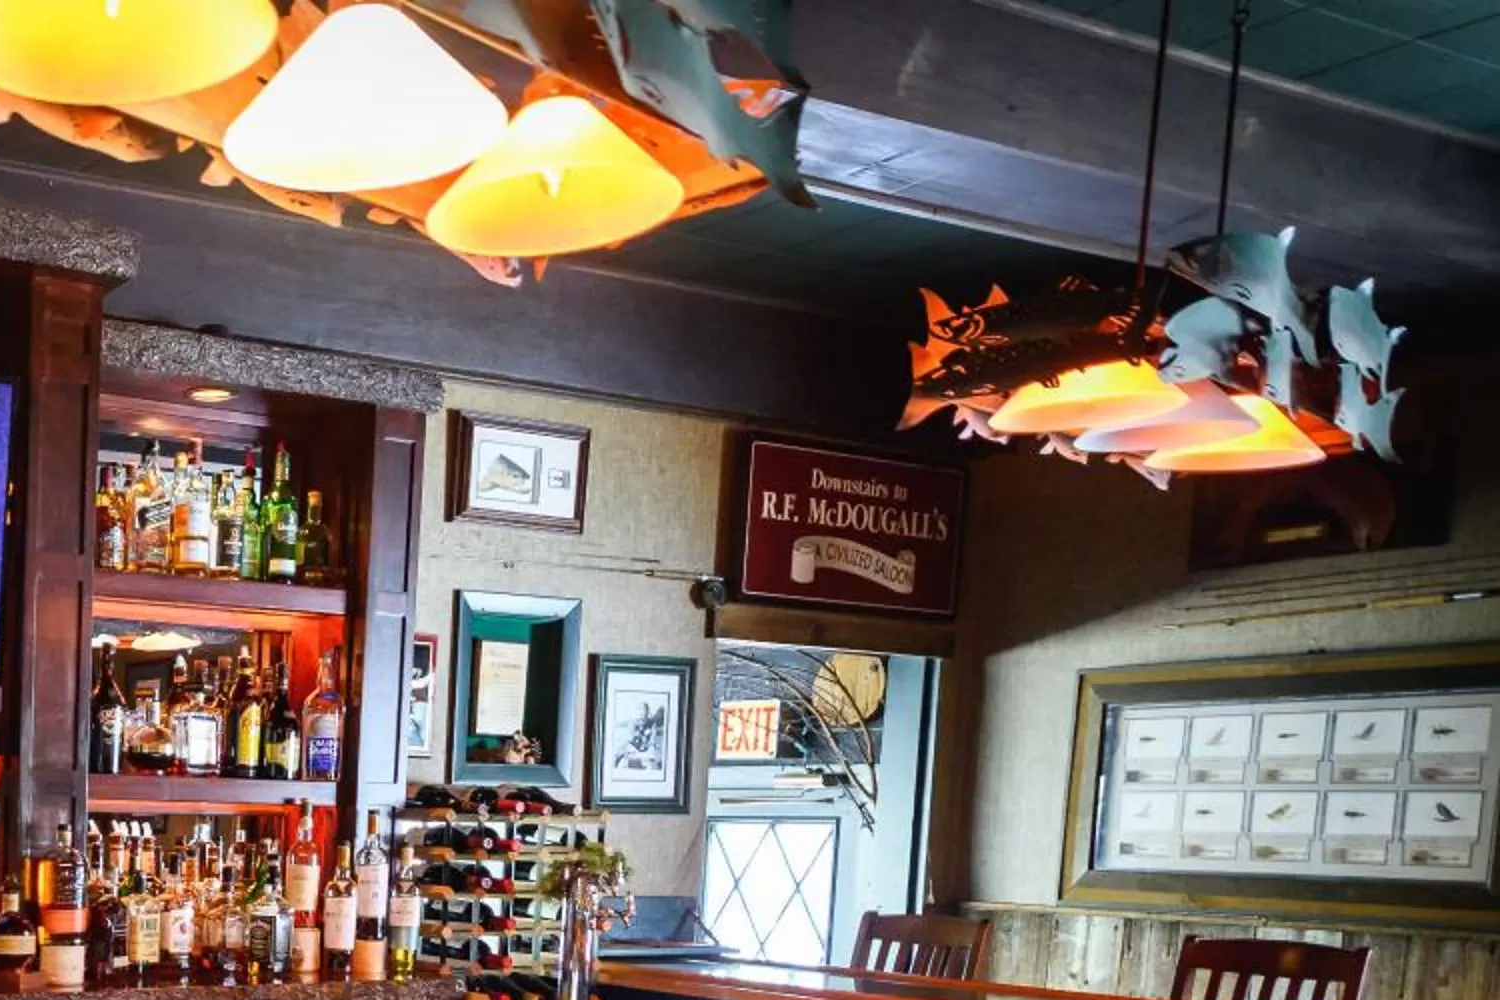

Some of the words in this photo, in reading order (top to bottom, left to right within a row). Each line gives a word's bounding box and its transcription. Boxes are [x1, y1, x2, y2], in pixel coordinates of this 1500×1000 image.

[810, 467, 889, 499] Downstairs
[760, 491, 799, 523] R.F.
[721, 706, 776, 752] EXIT
